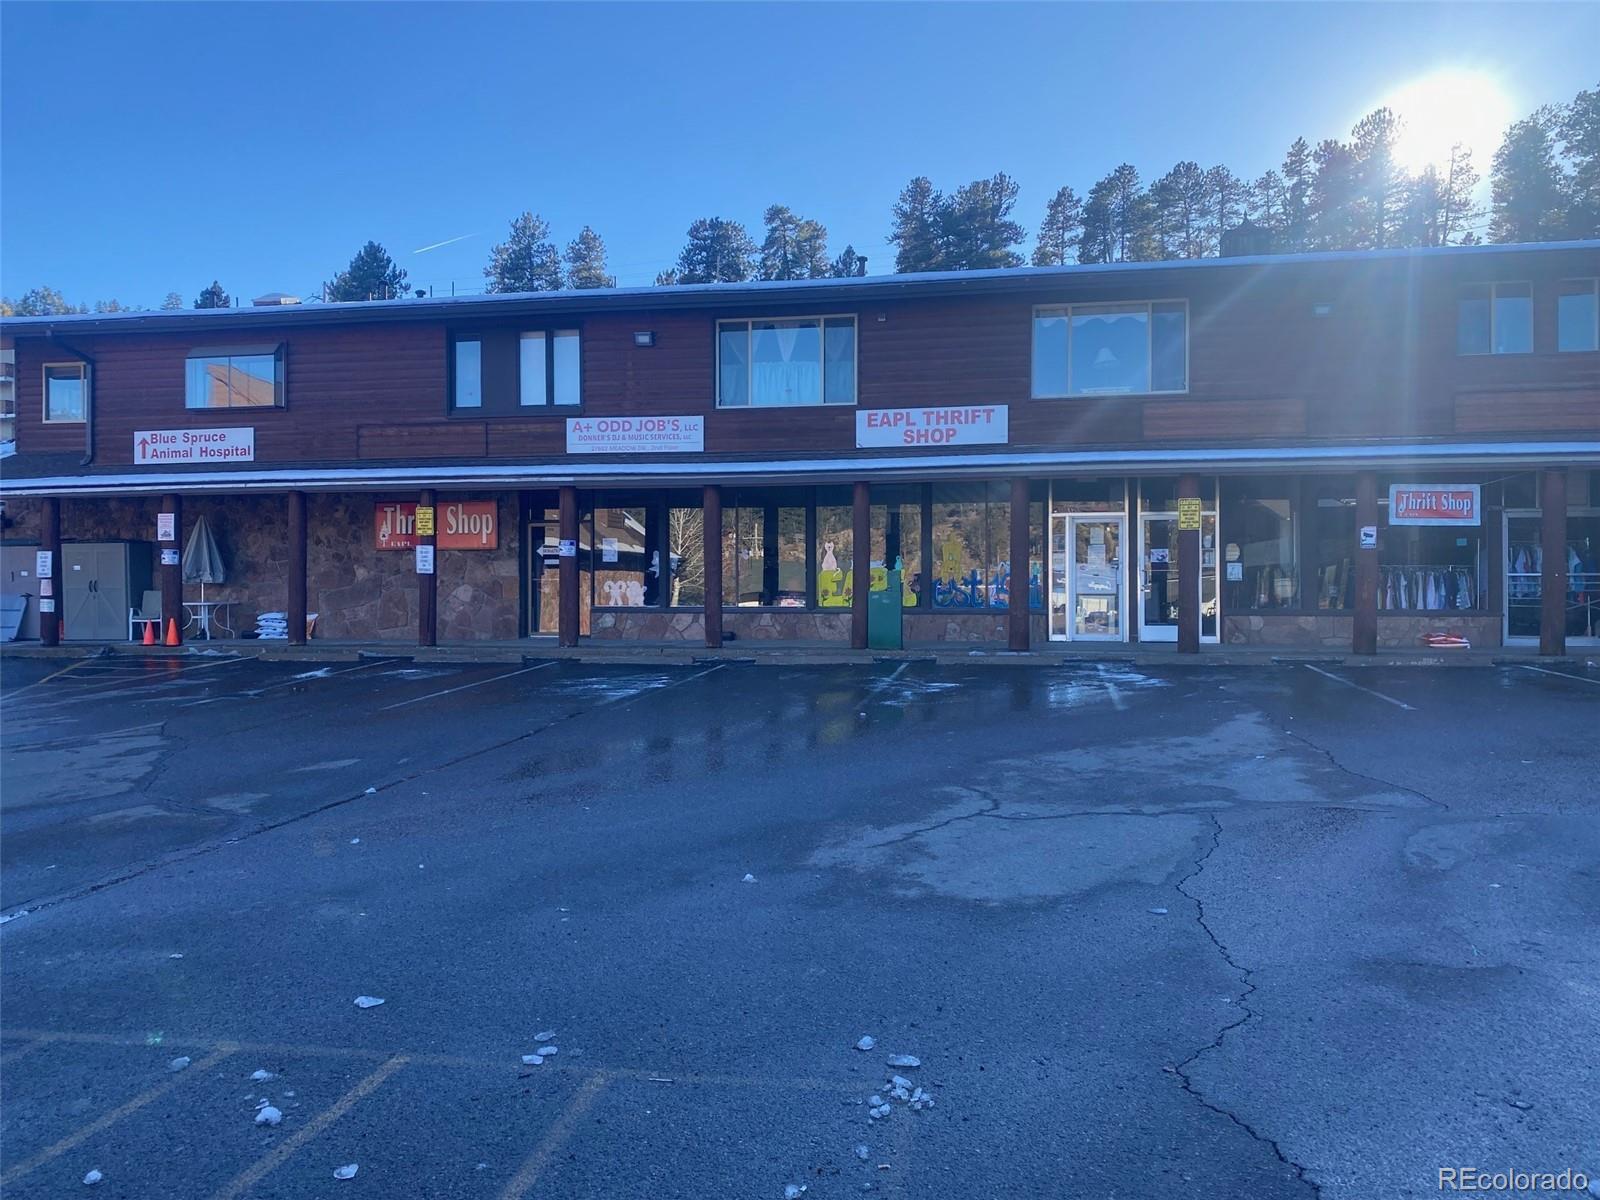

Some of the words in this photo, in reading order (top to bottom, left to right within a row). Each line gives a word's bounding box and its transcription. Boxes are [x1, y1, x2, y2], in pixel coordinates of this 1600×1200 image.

[867, 411, 917, 428] EAPL
[922, 408, 995, 425] THRIFT
[572, 421, 592, 433] A+
[597, 420, 632, 432] ODD
[684, 423, 699, 432] LLC
[150, 433, 177, 444] Blue
[182, 432, 226, 445] Spruce
[903, 428, 957, 444] SHOP
[151, 447, 193, 459] Animal
[200, 445, 251, 459] Hospital
[1399, 492, 1437, 513] Thrift
[1441, 493, 1472, 515] Shop
[446, 503, 493, 544] Shop
